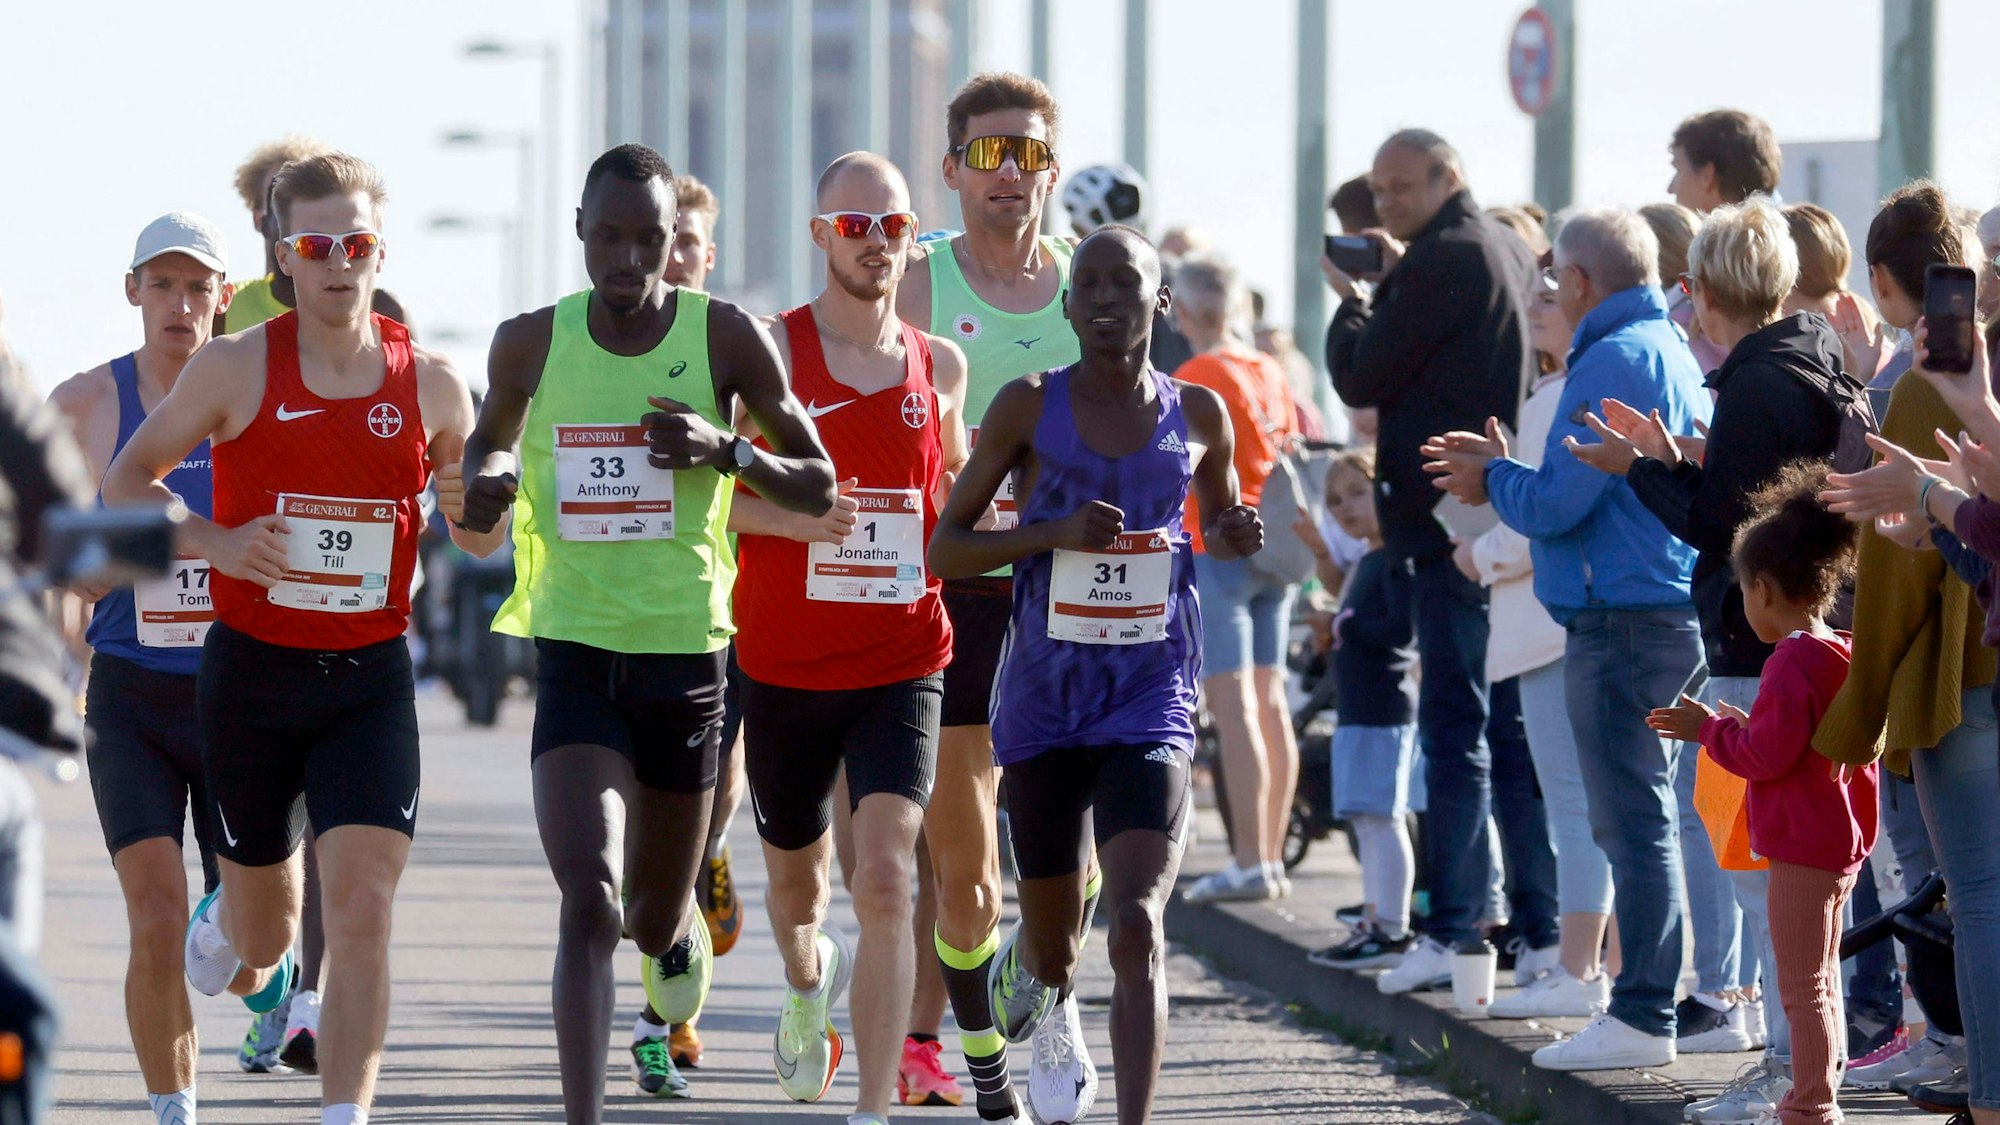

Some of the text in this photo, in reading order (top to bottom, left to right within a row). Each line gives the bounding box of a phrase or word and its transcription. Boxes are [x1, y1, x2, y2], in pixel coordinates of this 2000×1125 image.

[574, 431, 625, 443] GENERALI
[174, 460, 206, 470] RAFT
[589, 456, 625, 479] 33
[577, 483, 641, 498] Anthony
[305, 503, 358, 517] GENERALI
[620, 526, 643, 534] PUMA
[863, 521, 876, 543] 1
[317, 529, 353, 552] 39
[834, 546, 899, 561] Jonathan
[321, 554, 344, 568] Till
[176, 568, 210, 590] 17
[1093, 562, 1127, 584] 31
[177, 593, 210, 606] Tom
[878, 590, 898, 598] PUMA
[1087, 588, 1133, 601] Amos
[340, 599, 360, 607] PUMA
[1119, 630, 1140, 639] PUMA
